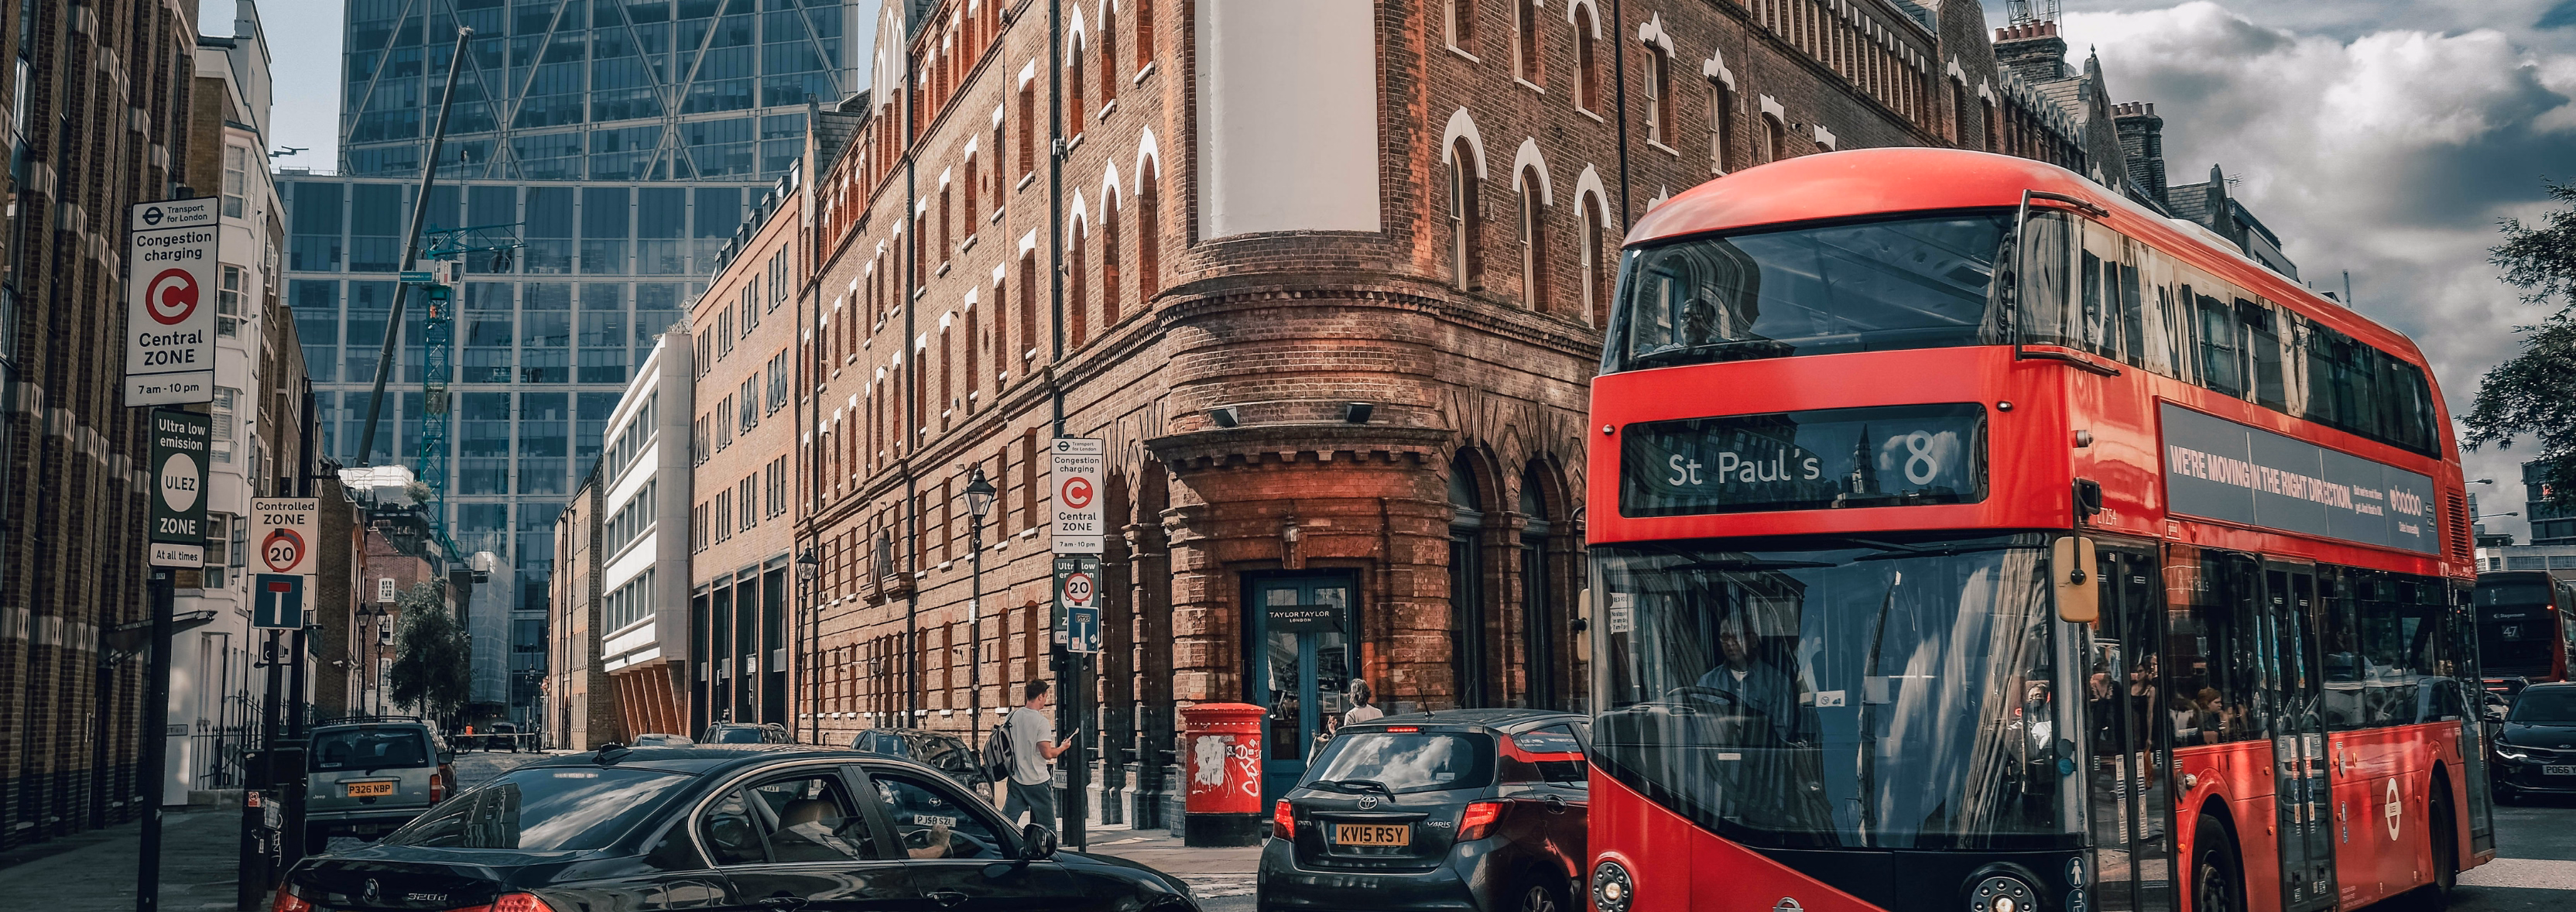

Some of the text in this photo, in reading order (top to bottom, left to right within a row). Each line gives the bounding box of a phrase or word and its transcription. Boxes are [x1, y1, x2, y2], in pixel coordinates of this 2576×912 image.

[167, 204, 204, 214] Transport
[136, 231, 212, 249] Congestion
[144, 247, 203, 262] charging
[139, 329, 203, 348] Central
[144, 349, 195, 365] ZONE
[170, 383, 182, 393] 10
[183, 384, 200, 394] pm
[159, 419, 206, 436] Ultra low
[160, 435, 203, 451] emission
[1668, 430, 1938, 487] St Paul's 8
[165, 475, 196, 492] ULEZ
[2170, 444, 2353, 510] WE'RE MOVING IN THE RIGHT DIRECTION.
[255, 502, 315, 511] Controlled
[2395, 485, 2422, 517] badoo
[263, 514, 305, 525] ZONE
[1059, 512, 1097, 520] Central
[2097, 507, 2117, 526] LT254
[159, 517, 197, 536] ZONE
[1062, 523, 1093, 531] ZONE
[156, 550, 198, 561] At all times
[270, 547, 294, 561] 20
[1069, 581, 1089, 594] 20
[2503, 626, 2518, 637] 47
[348, 784, 391, 794] P326 NBP
[917, 816, 937, 825] PJ58
[1341, 826, 1403, 843] KV15 RSY
[407, 893, 448, 901] 320d
